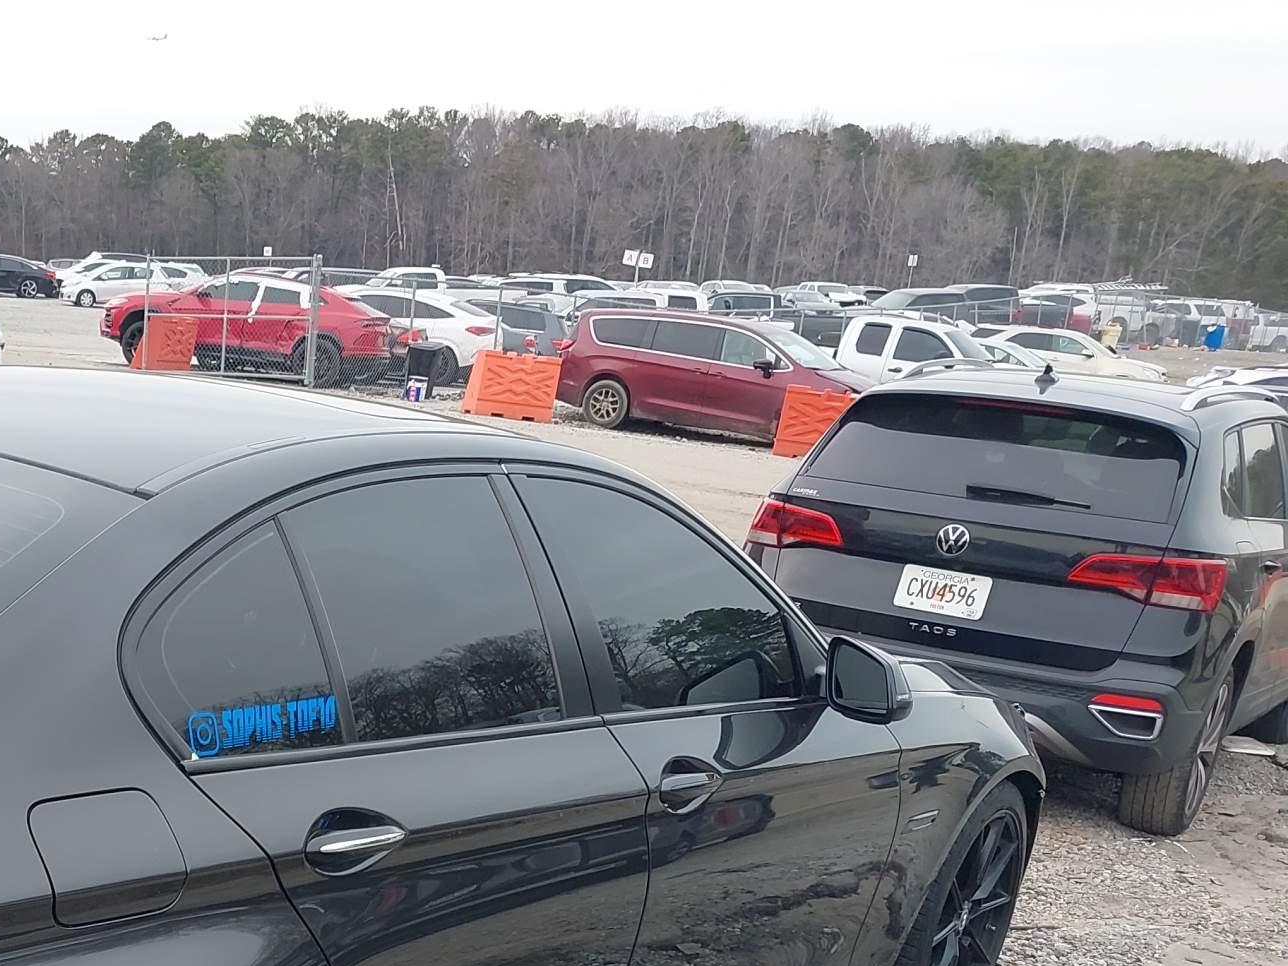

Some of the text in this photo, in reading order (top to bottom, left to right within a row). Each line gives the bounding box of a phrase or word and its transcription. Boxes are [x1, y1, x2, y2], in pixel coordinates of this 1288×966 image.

[922, 570, 970, 585] GEORGIA
[906, 577, 978, 607] CXU4596
[908, 622, 958, 637] TAOS
[222, 703, 282, 749] SOPHIS
